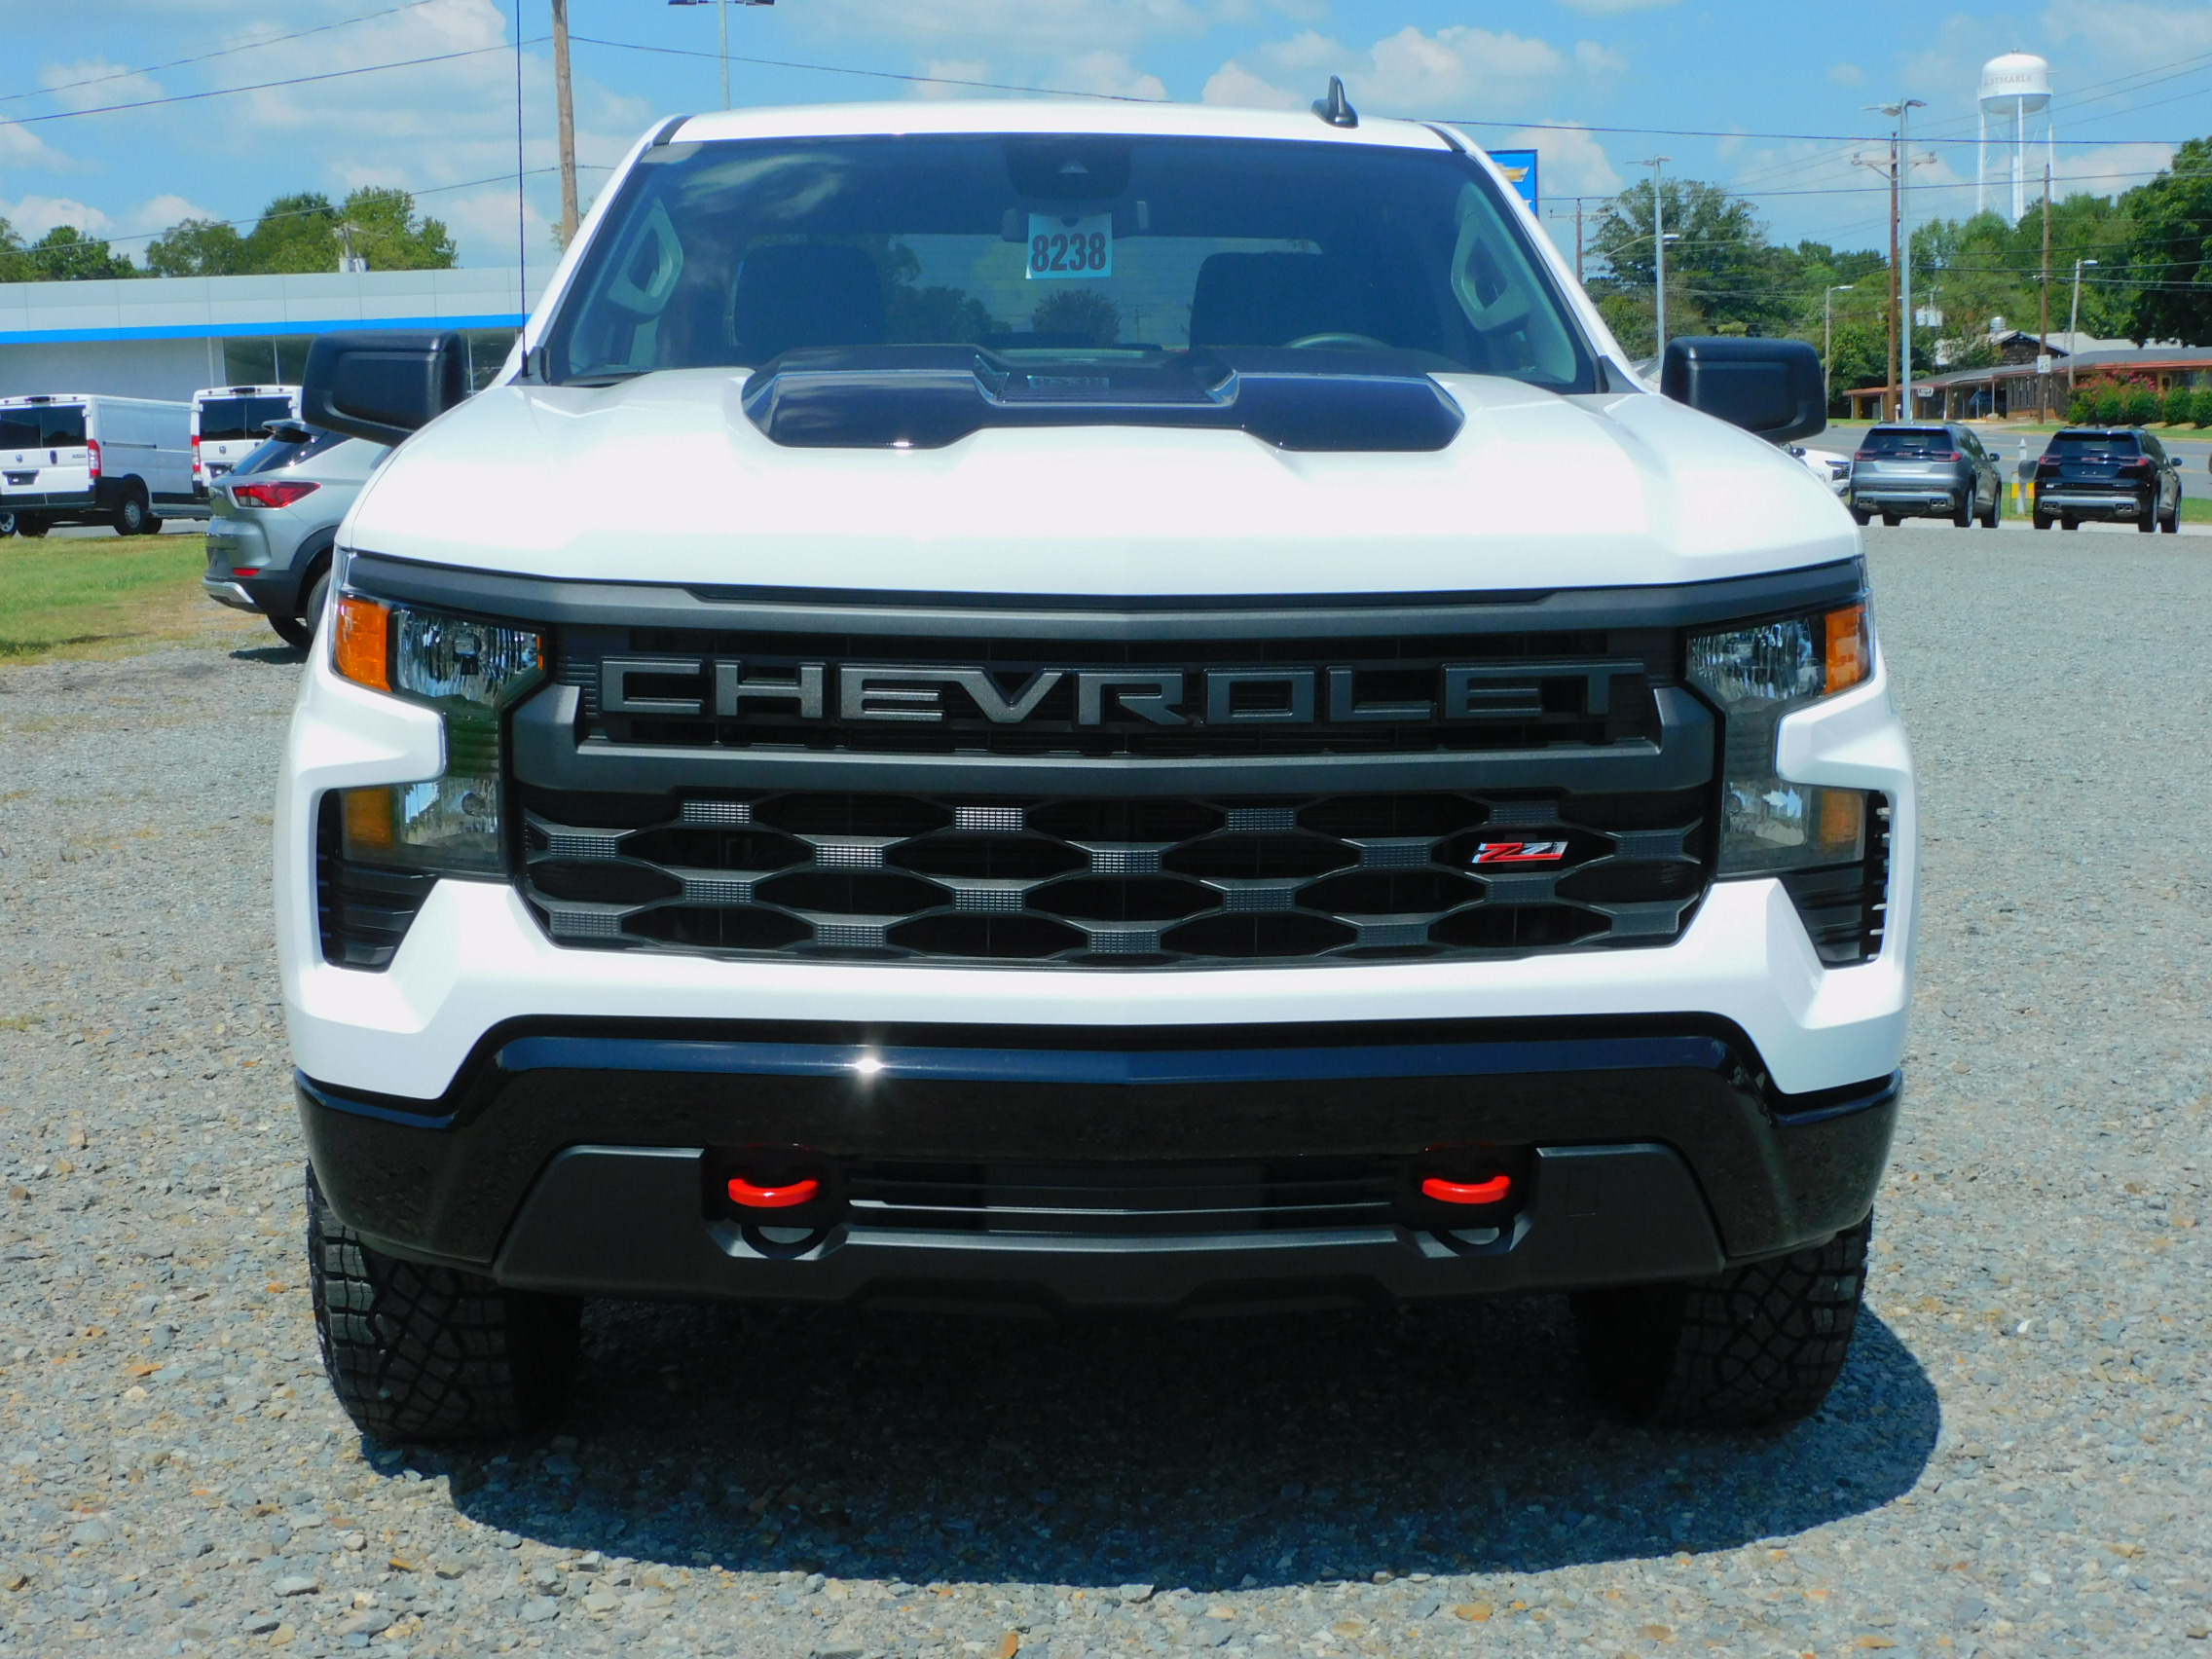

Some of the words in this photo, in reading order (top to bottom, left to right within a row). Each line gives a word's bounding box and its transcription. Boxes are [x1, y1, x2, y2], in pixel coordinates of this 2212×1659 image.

[1031, 232, 1106, 272] 8238
[601, 655, 1645, 725] CHEVROLET
[1471, 841, 1568, 864] Z71
